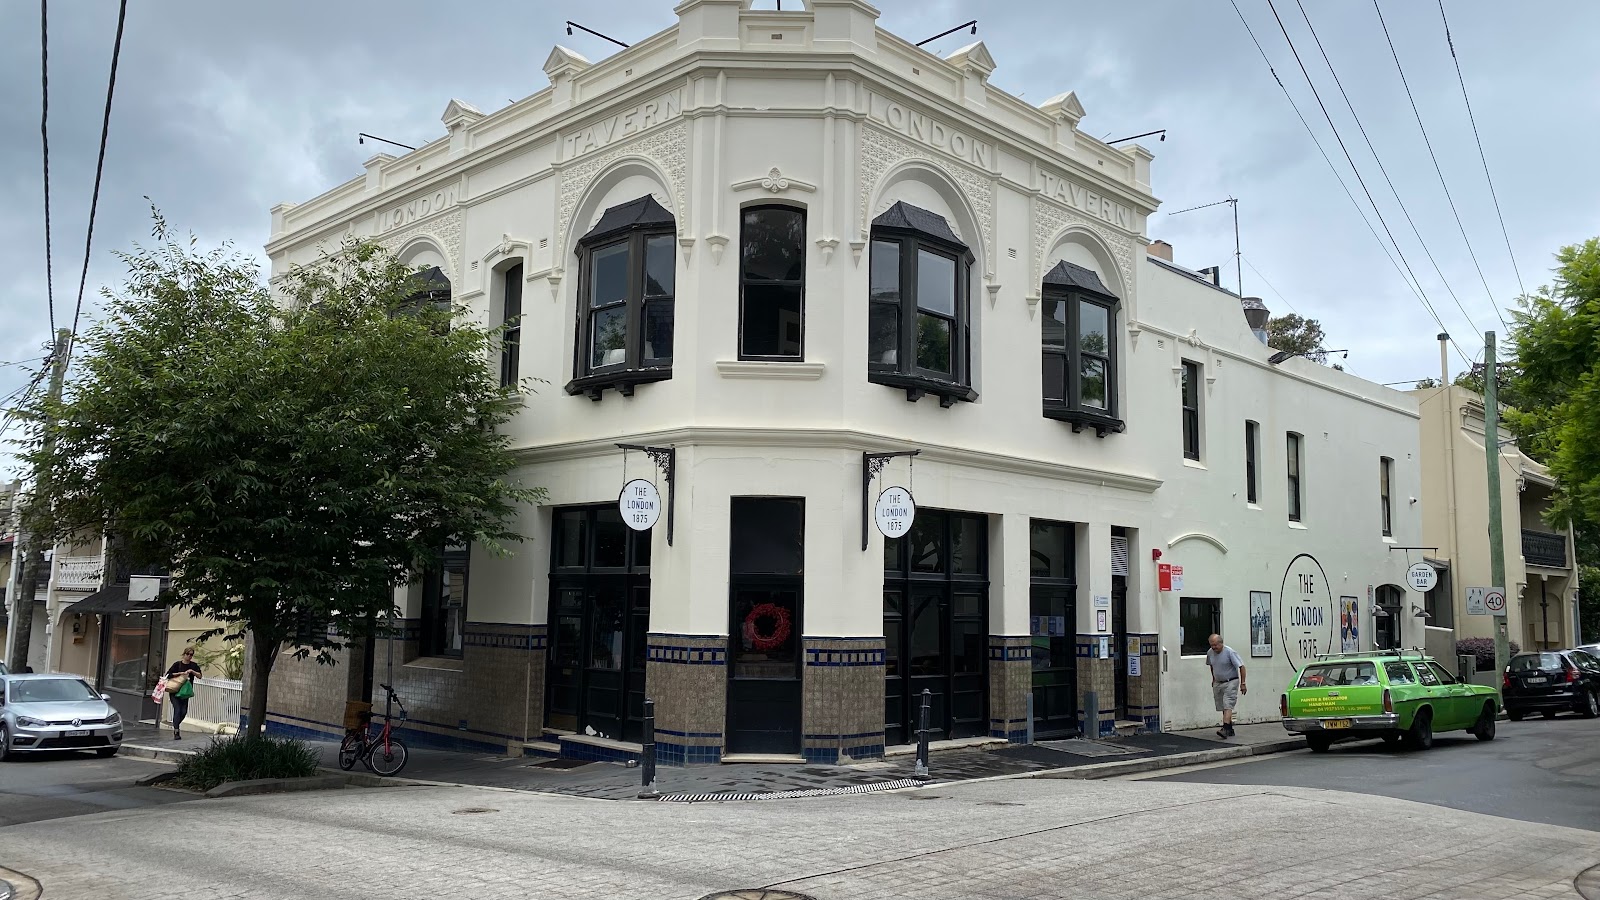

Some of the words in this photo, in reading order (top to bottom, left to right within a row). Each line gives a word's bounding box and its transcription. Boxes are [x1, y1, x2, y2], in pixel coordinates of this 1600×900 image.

[566, 88, 682, 158] TAVERN
[869, 91, 987, 168] LONDON
[381, 181, 460, 233] LONDON
[1040, 169, 1128, 228] TAVERN
[634, 486, 647, 496] THE
[889, 494, 901, 504] THE
[627, 500, 654, 510] LONDON
[882, 508, 908, 518] LONDON
[632, 514, 648, 523] 1875
[887, 521, 902, 531] 1875
[1298, 573, 1314, 594] THE
[1488, 597, 1502, 607] 40
[1290, 606, 1324, 627] LONDON
[1299, 639, 1318, 659] 1875
[1130, 657, 1138, 675] ENTRY
